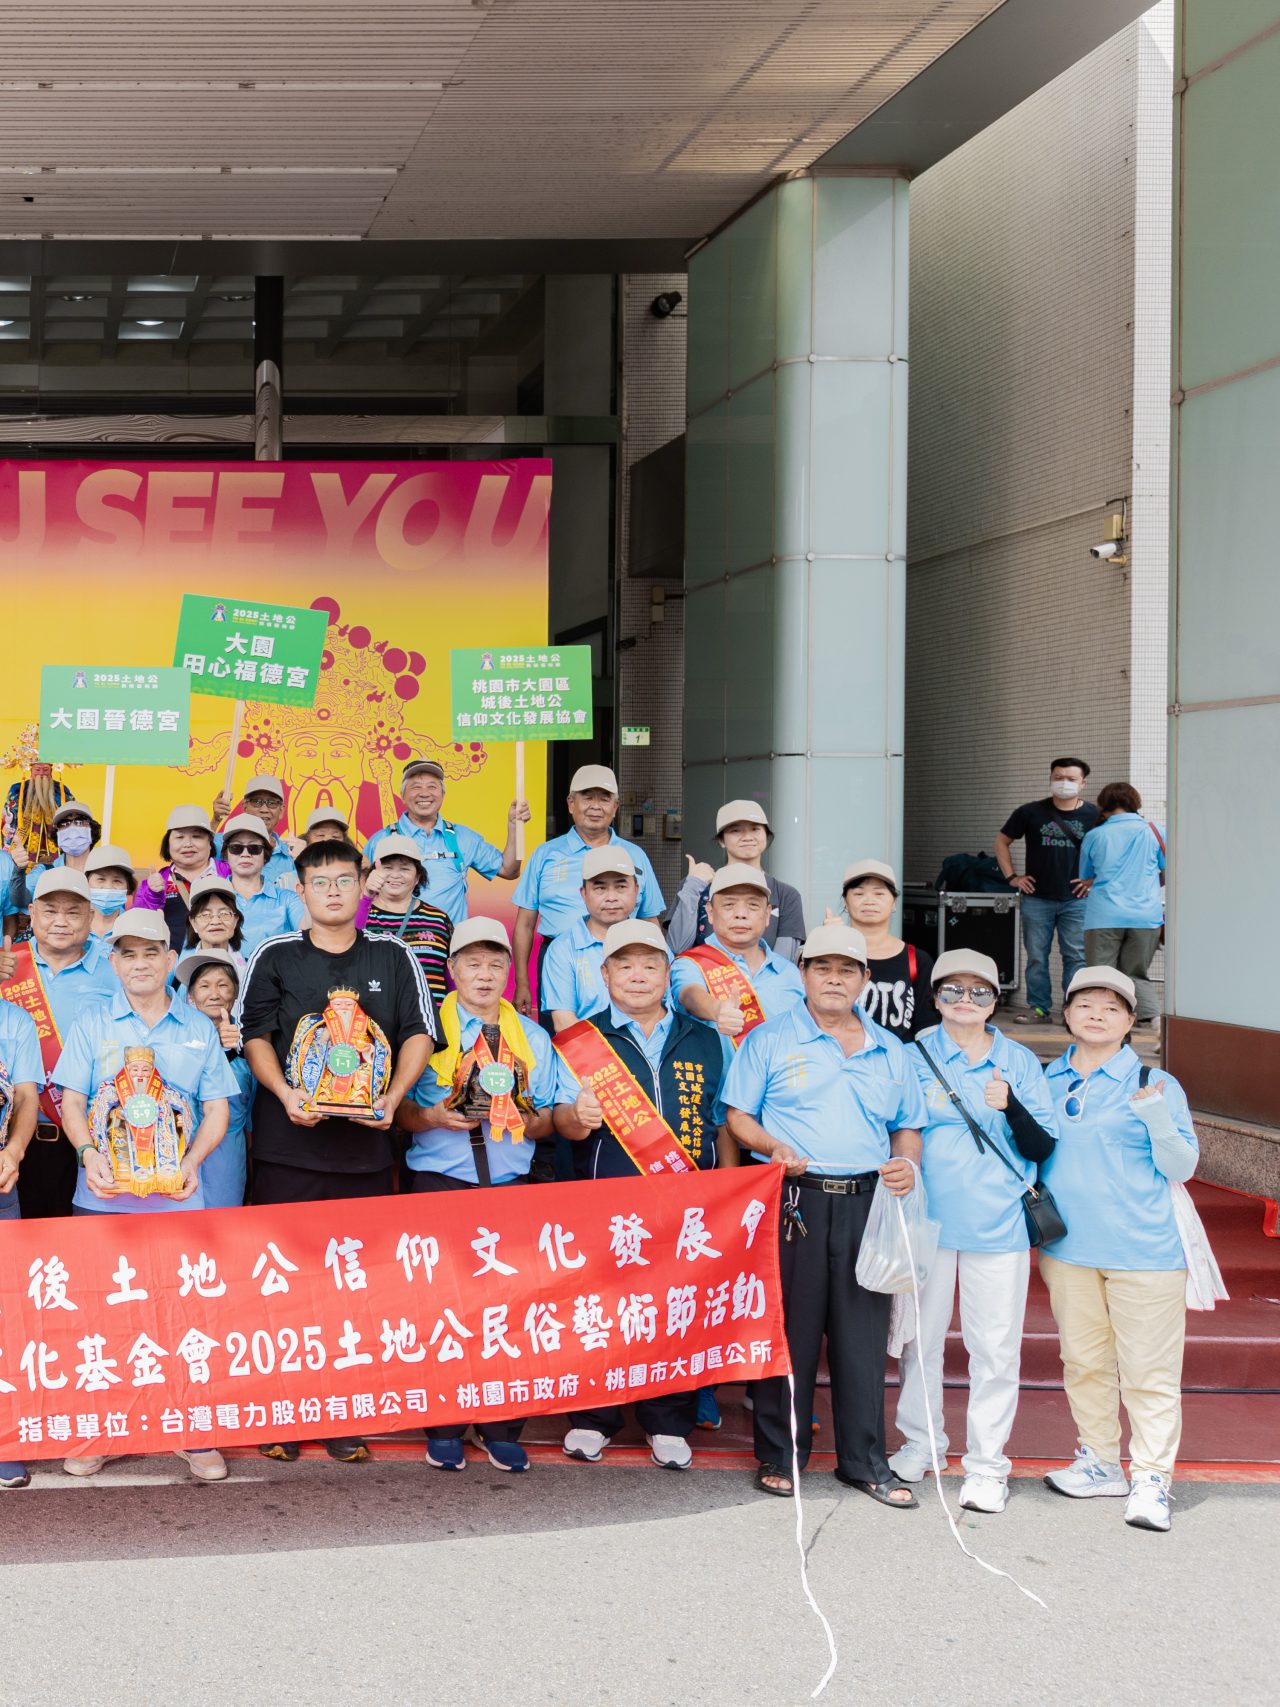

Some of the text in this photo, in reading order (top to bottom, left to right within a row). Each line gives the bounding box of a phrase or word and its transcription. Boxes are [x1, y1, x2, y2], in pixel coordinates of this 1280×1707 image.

[75, 468, 285, 560] SEE
[309, 470, 552, 571] YOU
[224, 632, 275, 659] 大園
[182, 653, 310, 689] 田心福德宮
[471, 677, 570, 694] 桃園市大園區
[480, 694, 562, 710] 城後土地公
[49, 707, 180, 732] 大園晉德宮
[456, 709, 587, 728] 信仰文化發展協會
[4, 978, 36, 997] 2025
[336, 1058, 350, 1068] 1-1
[489, 1077, 506, 1087] 1-2
[613, 1080, 652, 1127] 土地公
